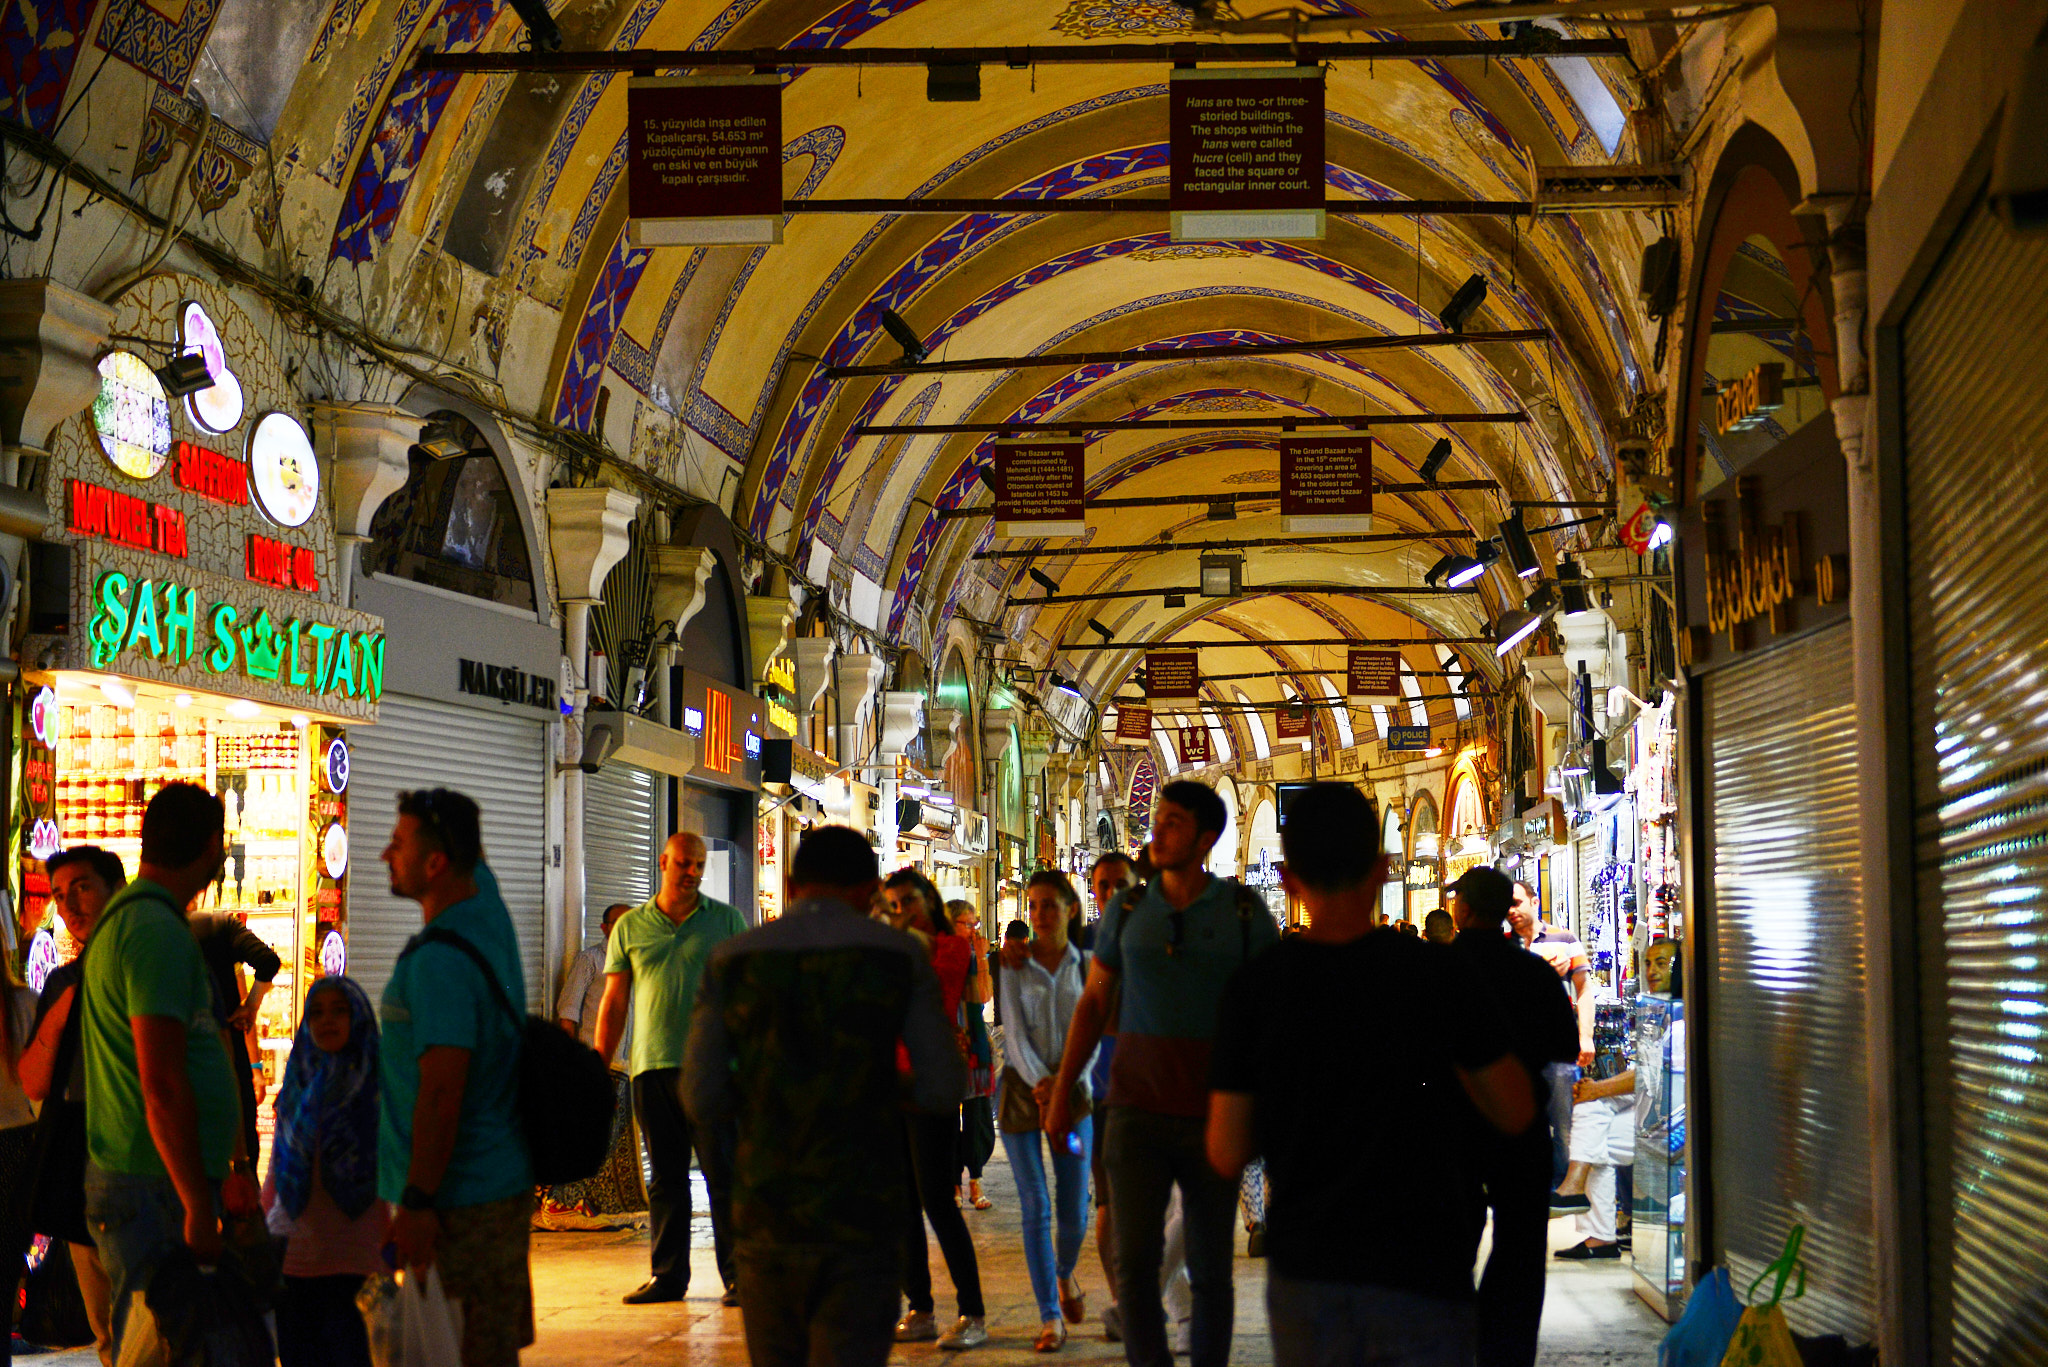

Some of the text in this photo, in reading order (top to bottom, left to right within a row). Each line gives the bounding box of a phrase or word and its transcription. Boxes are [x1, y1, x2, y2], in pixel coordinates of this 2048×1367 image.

[1186, 98, 1213, 108] Hans
[1216, 98, 1233, 107] are
[1236, 98, 1255, 107] two
[1277, 96, 1308, 106] three-
[1200, 111, 1294, 122] storied buildings.
[643, 117, 766, 131] 15. yüzyılda inşa edilen
[1191, 124, 1303, 137] The shops within the
[647, 133, 709, 144] Kapalıçarşı,
[712, 131, 746, 142] 54.653
[1202, 138, 1292, 149] hans were called
[642, 145, 768, 160] yüzölçümüyle dünyanın
[1192, 151, 1301, 164] hucre (cell) and they
[652, 158, 758, 171] en eski ve en büyük
[662, 173, 749, 185] kapalı çarşısıdır.
[1195, 167, 1299, 178] faced the square or
[1184, 180, 1310, 193] rectangular inner court.
[174, 439, 248, 506] SAFFRON
[1290, 489, 1312, 497] largest
[997, 499, 1021, 507] provide
[1023, 507, 1041, 515] Hagia
[68, 478, 187, 559] NATUREL TEA
[248, 534, 319, 593] ROSE OIL
[1814, 554, 1834, 607] 10
[91, 569, 197, 668] ŞAH
[459, 658, 557, 710] NAKŞİLER
[1402, 731, 1428, 739] POLICE
[1185, 747, 1205, 755] WC
[26, 759, 53, 781] APPLE
[31, 782, 49, 803] TEA
